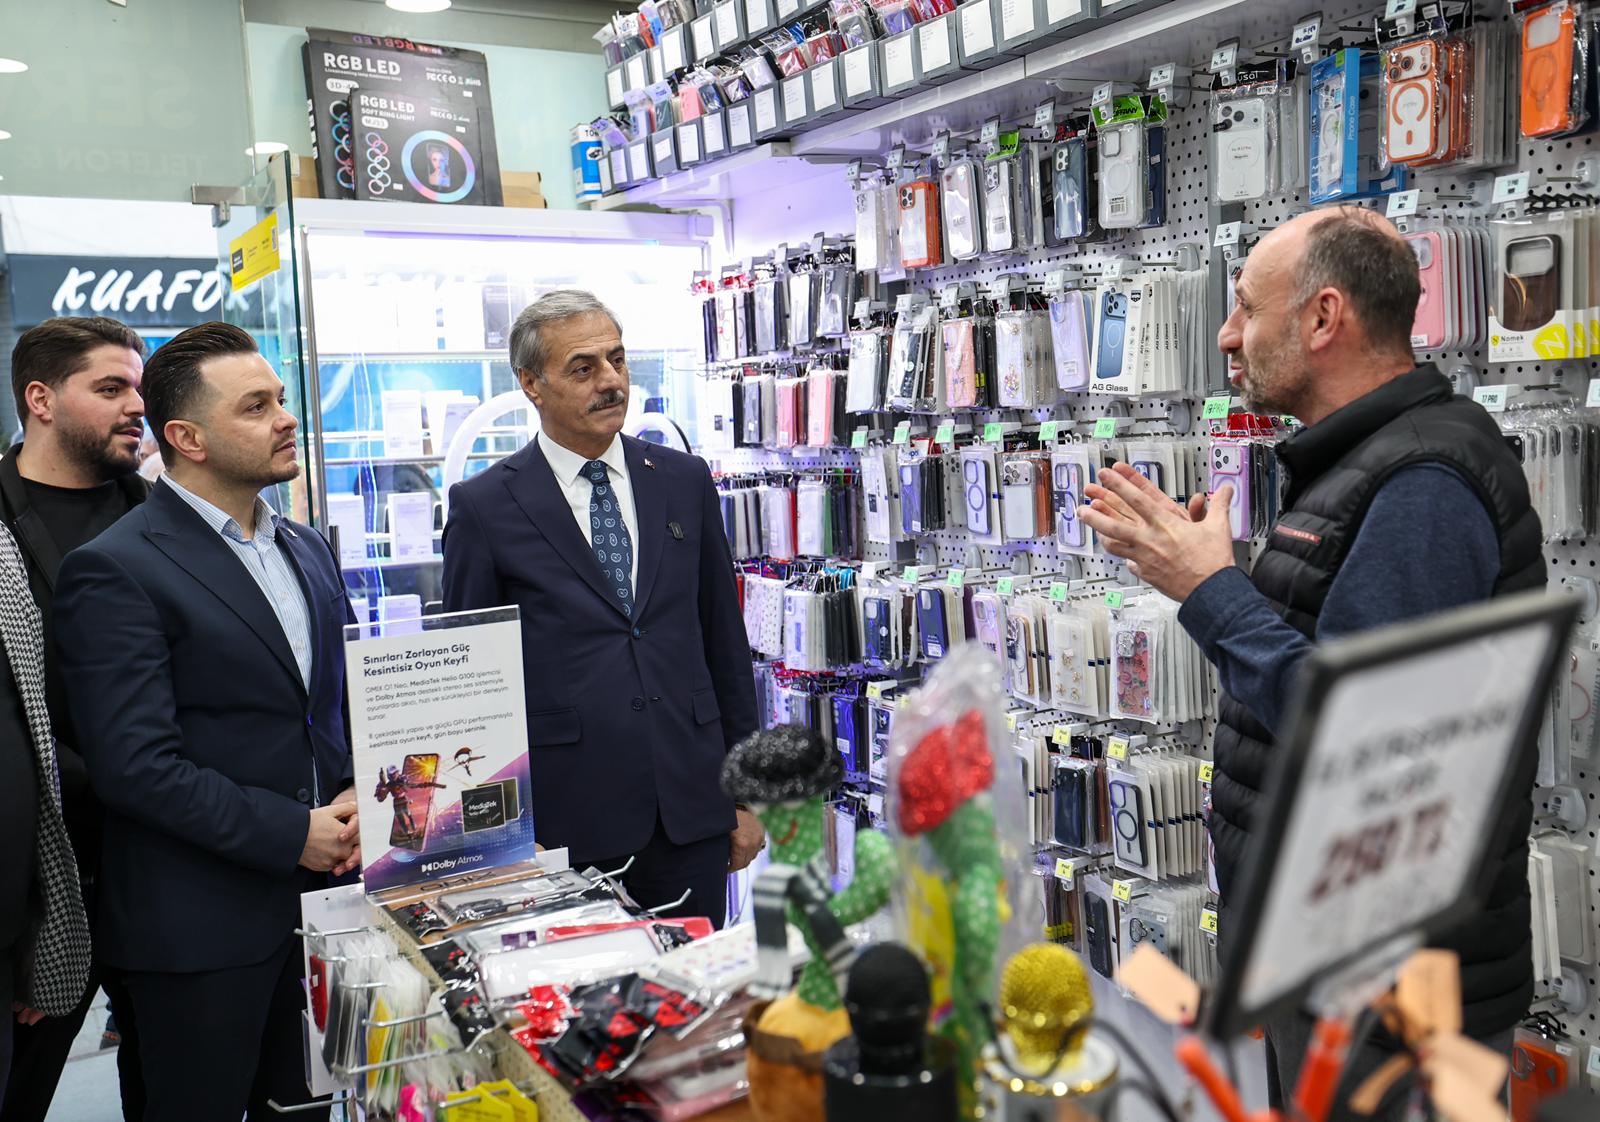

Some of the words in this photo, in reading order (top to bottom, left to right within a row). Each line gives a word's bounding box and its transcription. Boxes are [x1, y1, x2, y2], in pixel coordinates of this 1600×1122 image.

[323, 52, 362, 71] RGB
[366, 57, 401, 75] LED
[360, 94, 388, 109] RGB
[390, 100, 415, 113] LED
[1348, 95, 1356, 116] Case
[361, 107, 378, 116] SOFT
[379, 110, 395, 119] RING
[396, 113, 415, 122] LIGHT
[1092, 383, 1105, 391] AG
[1105, 384, 1129, 392] Glass
[1488, 394, 1498, 403] PRO
[363, 652, 403, 665] Sınırları
[405, 647, 449, 660] Zorlayan
[451, 643, 470, 654] Güç
[364, 662, 413, 677] Kesintisiz
[415, 657, 441, 671] Oyun
[444, 654, 469, 667] Keyfi
[375, 692, 394, 702] Dolby
[395, 690, 416, 699] Atmos
[417, 687, 441, 696] destekli
[443, 684, 462, 692] stereo
[475, 678, 504, 688] sistemiyle
[409, 677, 440, 687] MediaTek
[442, 675, 457, 683] Helio
[458, 672, 475, 680] G100
[366, 702, 399, 713] oyunlarda
[418, 696, 431, 704] hızlı
[441, 691, 473, 702] sürükleyici
[473, 689, 482, 697] bir
[483, 685, 509, 695] deneyim
[374, 729, 405, 740] çekirdekli
[434, 720, 452, 731] güçlü
[453, 718, 467, 726] GPU
[468, 711, 513, 724] performansıyla
[369, 738, 398, 749] kesintisiz
[399, 737, 415, 745] oyun
[416, 733, 433, 742] keyfi,
[434, 731, 446, 739] gün
[447, 728, 463, 737] boyu
[468, 800, 497, 812] MediaTek
[433, 860, 456, 871] Dolby
[457, 854, 483, 865] Atmos
